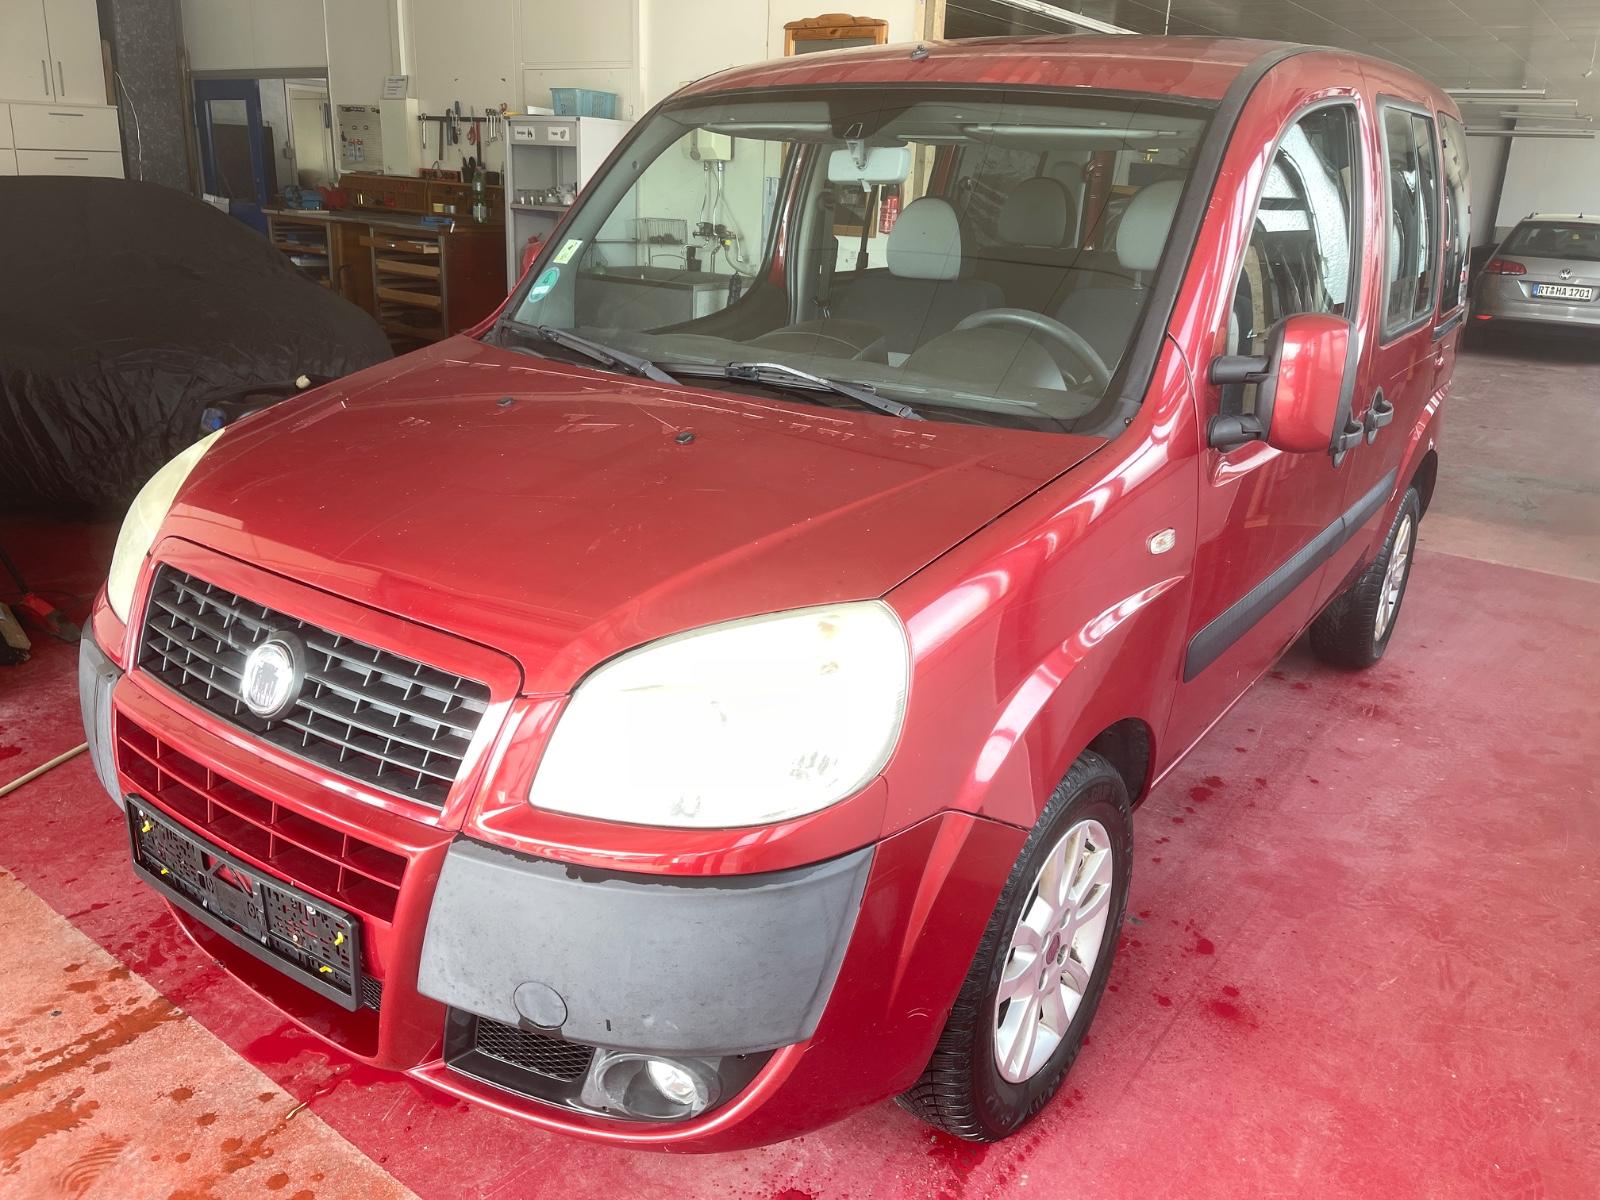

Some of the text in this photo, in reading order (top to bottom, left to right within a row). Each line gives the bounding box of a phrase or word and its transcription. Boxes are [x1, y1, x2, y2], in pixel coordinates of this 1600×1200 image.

[1538, 286, 1590, 298] RT HA 1701
